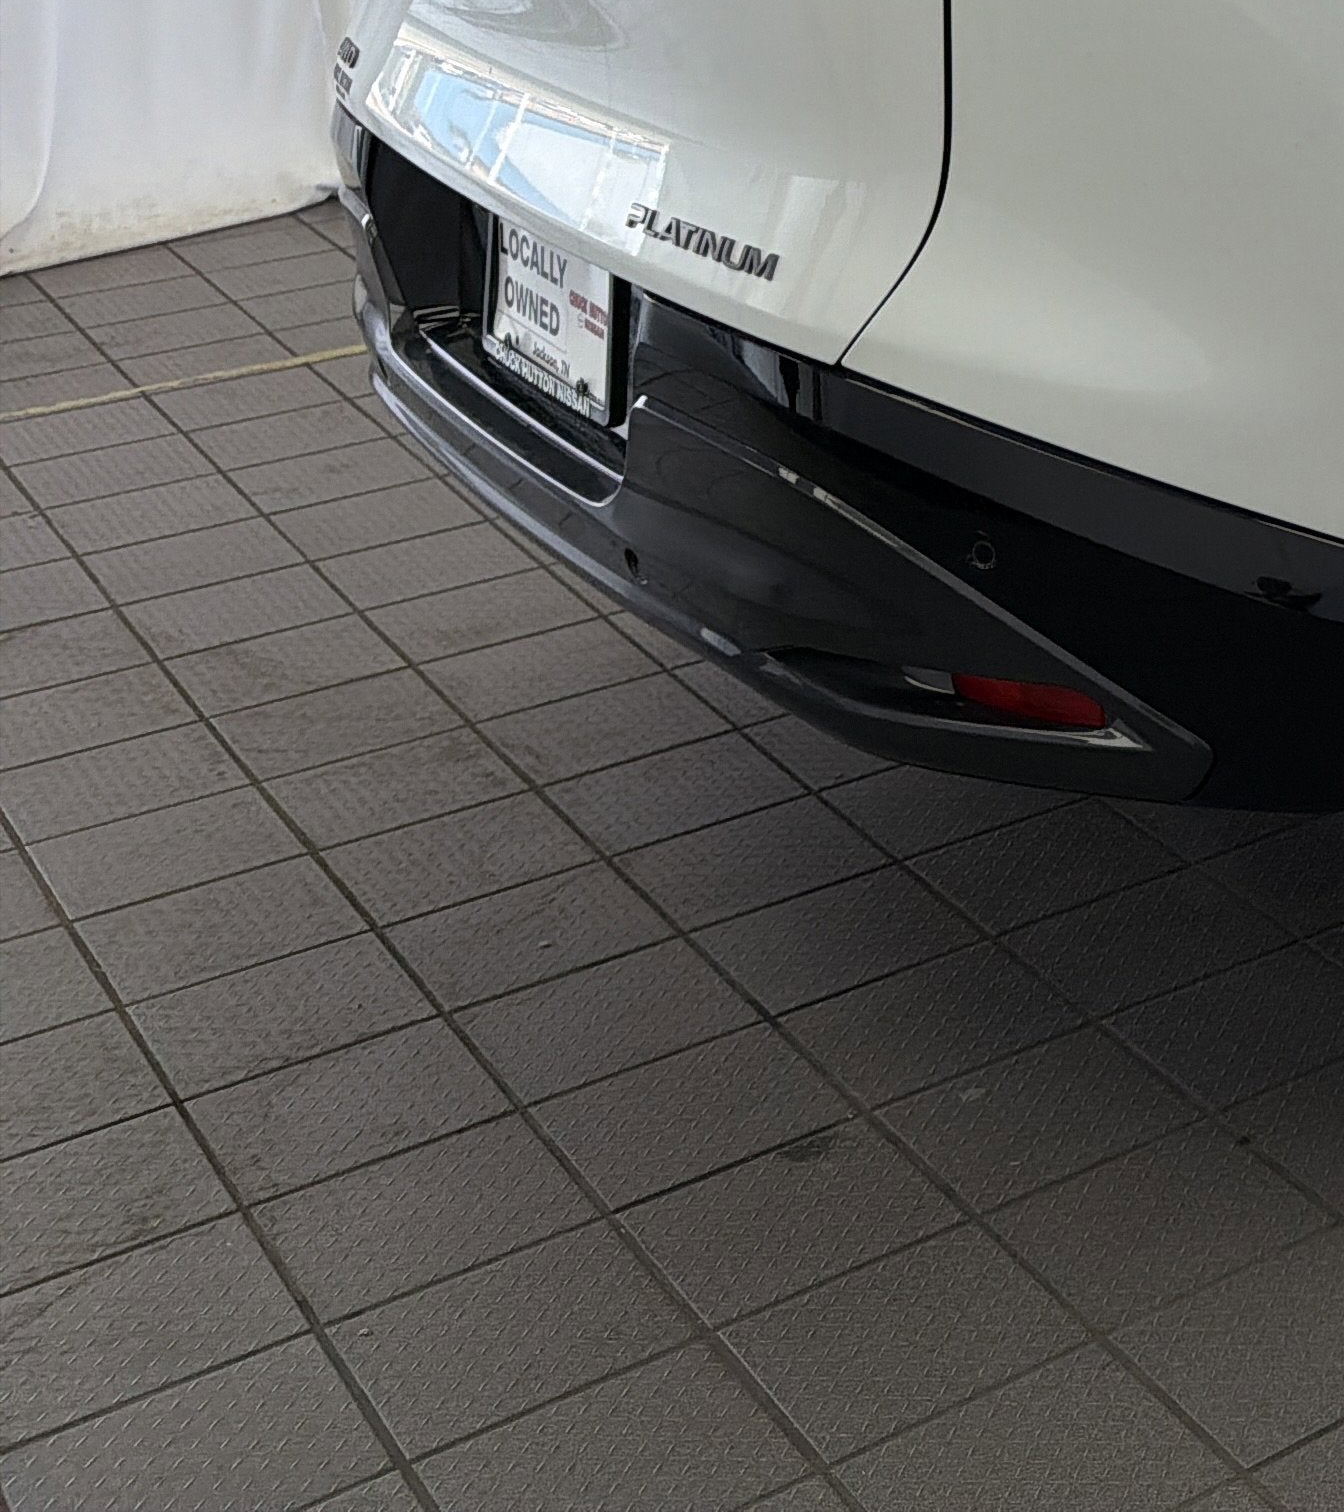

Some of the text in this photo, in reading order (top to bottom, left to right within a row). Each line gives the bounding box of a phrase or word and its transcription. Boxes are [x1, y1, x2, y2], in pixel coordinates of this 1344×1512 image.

[500, 222, 568, 289] LOCALLY
[625, 202, 780, 281] PLATINUM
[504, 276, 560, 337] OWNED
[495, 343, 591, 419] CHUCK HUTTON NISSAN
